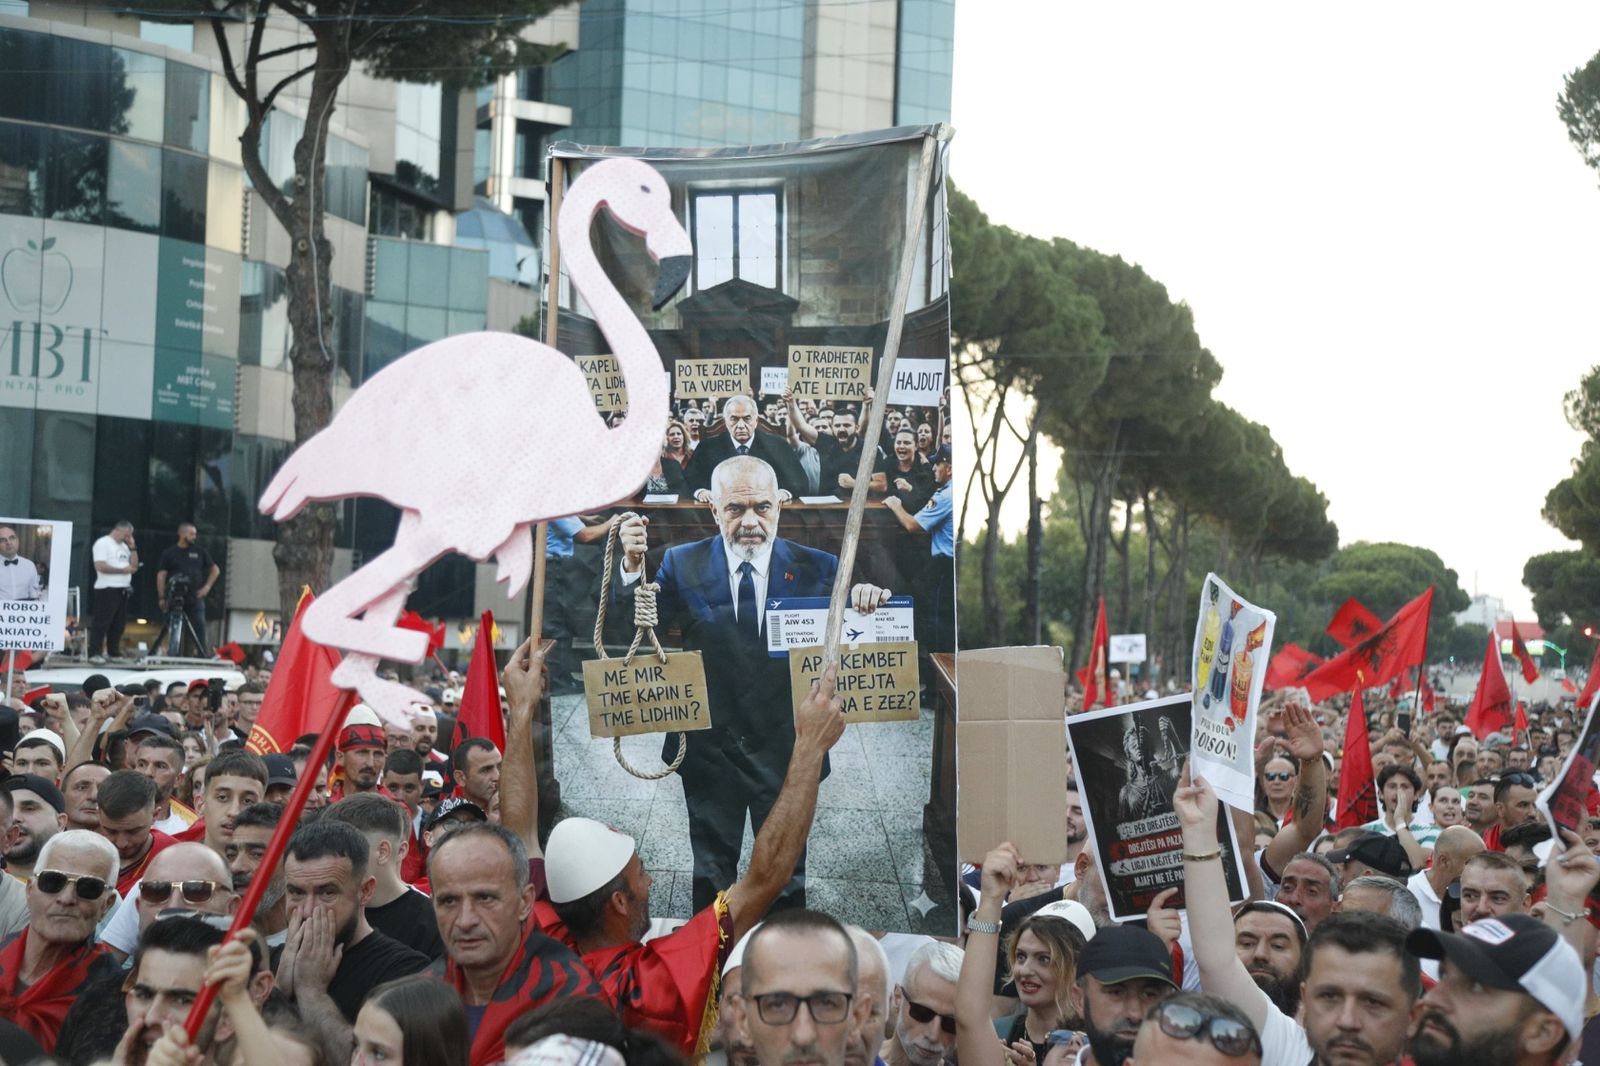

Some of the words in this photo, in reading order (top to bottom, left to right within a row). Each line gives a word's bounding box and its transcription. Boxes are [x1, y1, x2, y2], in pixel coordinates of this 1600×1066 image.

[792, 350, 801, 363] O
[806, 350, 869, 365] TRADHETAR
[580, 359, 610, 374] KAPE
[678, 364, 692, 377] PO
[696, 364, 708, 376] TE
[712, 363, 748, 376] ZUREM
[799, 366, 810, 379] TI
[815, 366, 860, 379] MERITO
[682, 381, 697, 393] TA
[700, 379, 742, 392] VUREM
[793, 381, 819, 395] ATE
[825, 381, 865, 396] LITAR
[895, 371, 943, 392] HAJDUT
[595, 393, 604, 407] E
[3, 602, 39, 612] ROBO
[8, 615, 27, 624] BO
[801, 636, 818, 644] AVIV
[840, 651, 907, 671] KEMBET
[604, 670, 628, 687] ME
[634, 666, 666, 683] MIR
[836, 673, 896, 692] HPEJTA
[598, 690, 632, 707] TME
[636, 685, 680, 704] KAPIN
[684, 684, 693, 698] E
[864, 696, 873, 711] E
[600, 709, 635, 728] TME
[640, 700, 701, 724] LIDHIN?
[1194, 727, 1237, 761] POISON!
